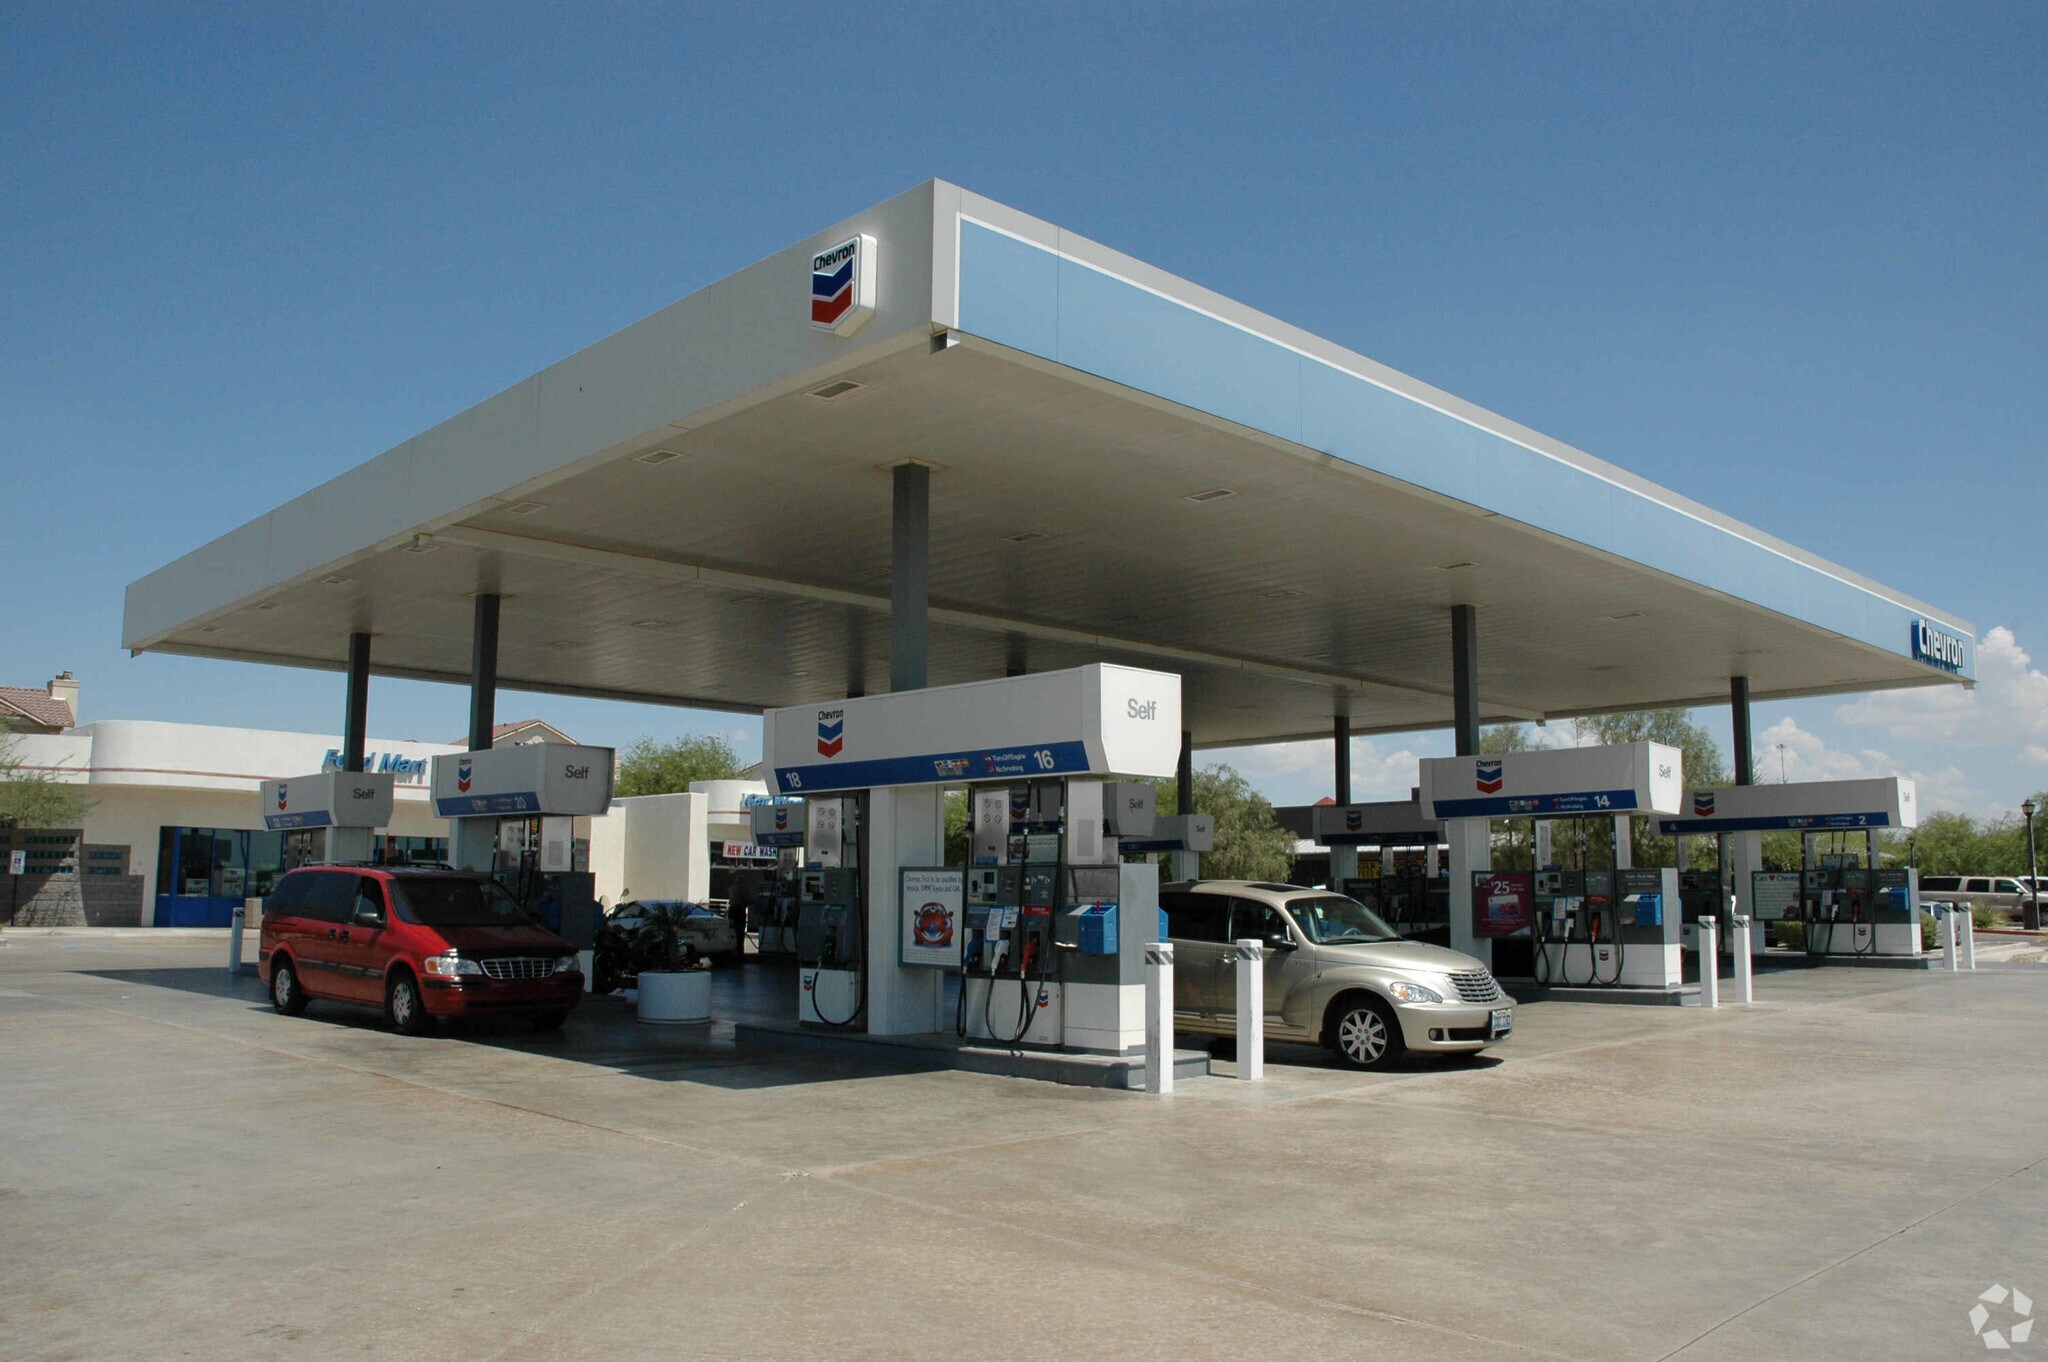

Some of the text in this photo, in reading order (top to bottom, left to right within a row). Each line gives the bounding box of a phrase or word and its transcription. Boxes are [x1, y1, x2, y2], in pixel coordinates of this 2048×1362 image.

[813, 243, 855, 271] Chevron
[1918, 618, 1965, 668] Chevron
[818, 710, 844, 720] Chevron
[1127, 698, 1157, 720] Self
[378, 753, 428, 774] Mart
[1033, 750, 1055, 769] 16
[1476, 760, 1502, 768] Chevron
[565, 764, 590, 779] Self
[1658, 764, 1672, 780] Self
[786, 772, 802, 788] 18
[353, 788, 375, 800] Self
[1594, 794, 1611, 808] 14
[1129, 799, 1144, 810] Self
[1858, 815, 1867, 825] 2
[727, 844, 777, 857] NEW CAR WASH
